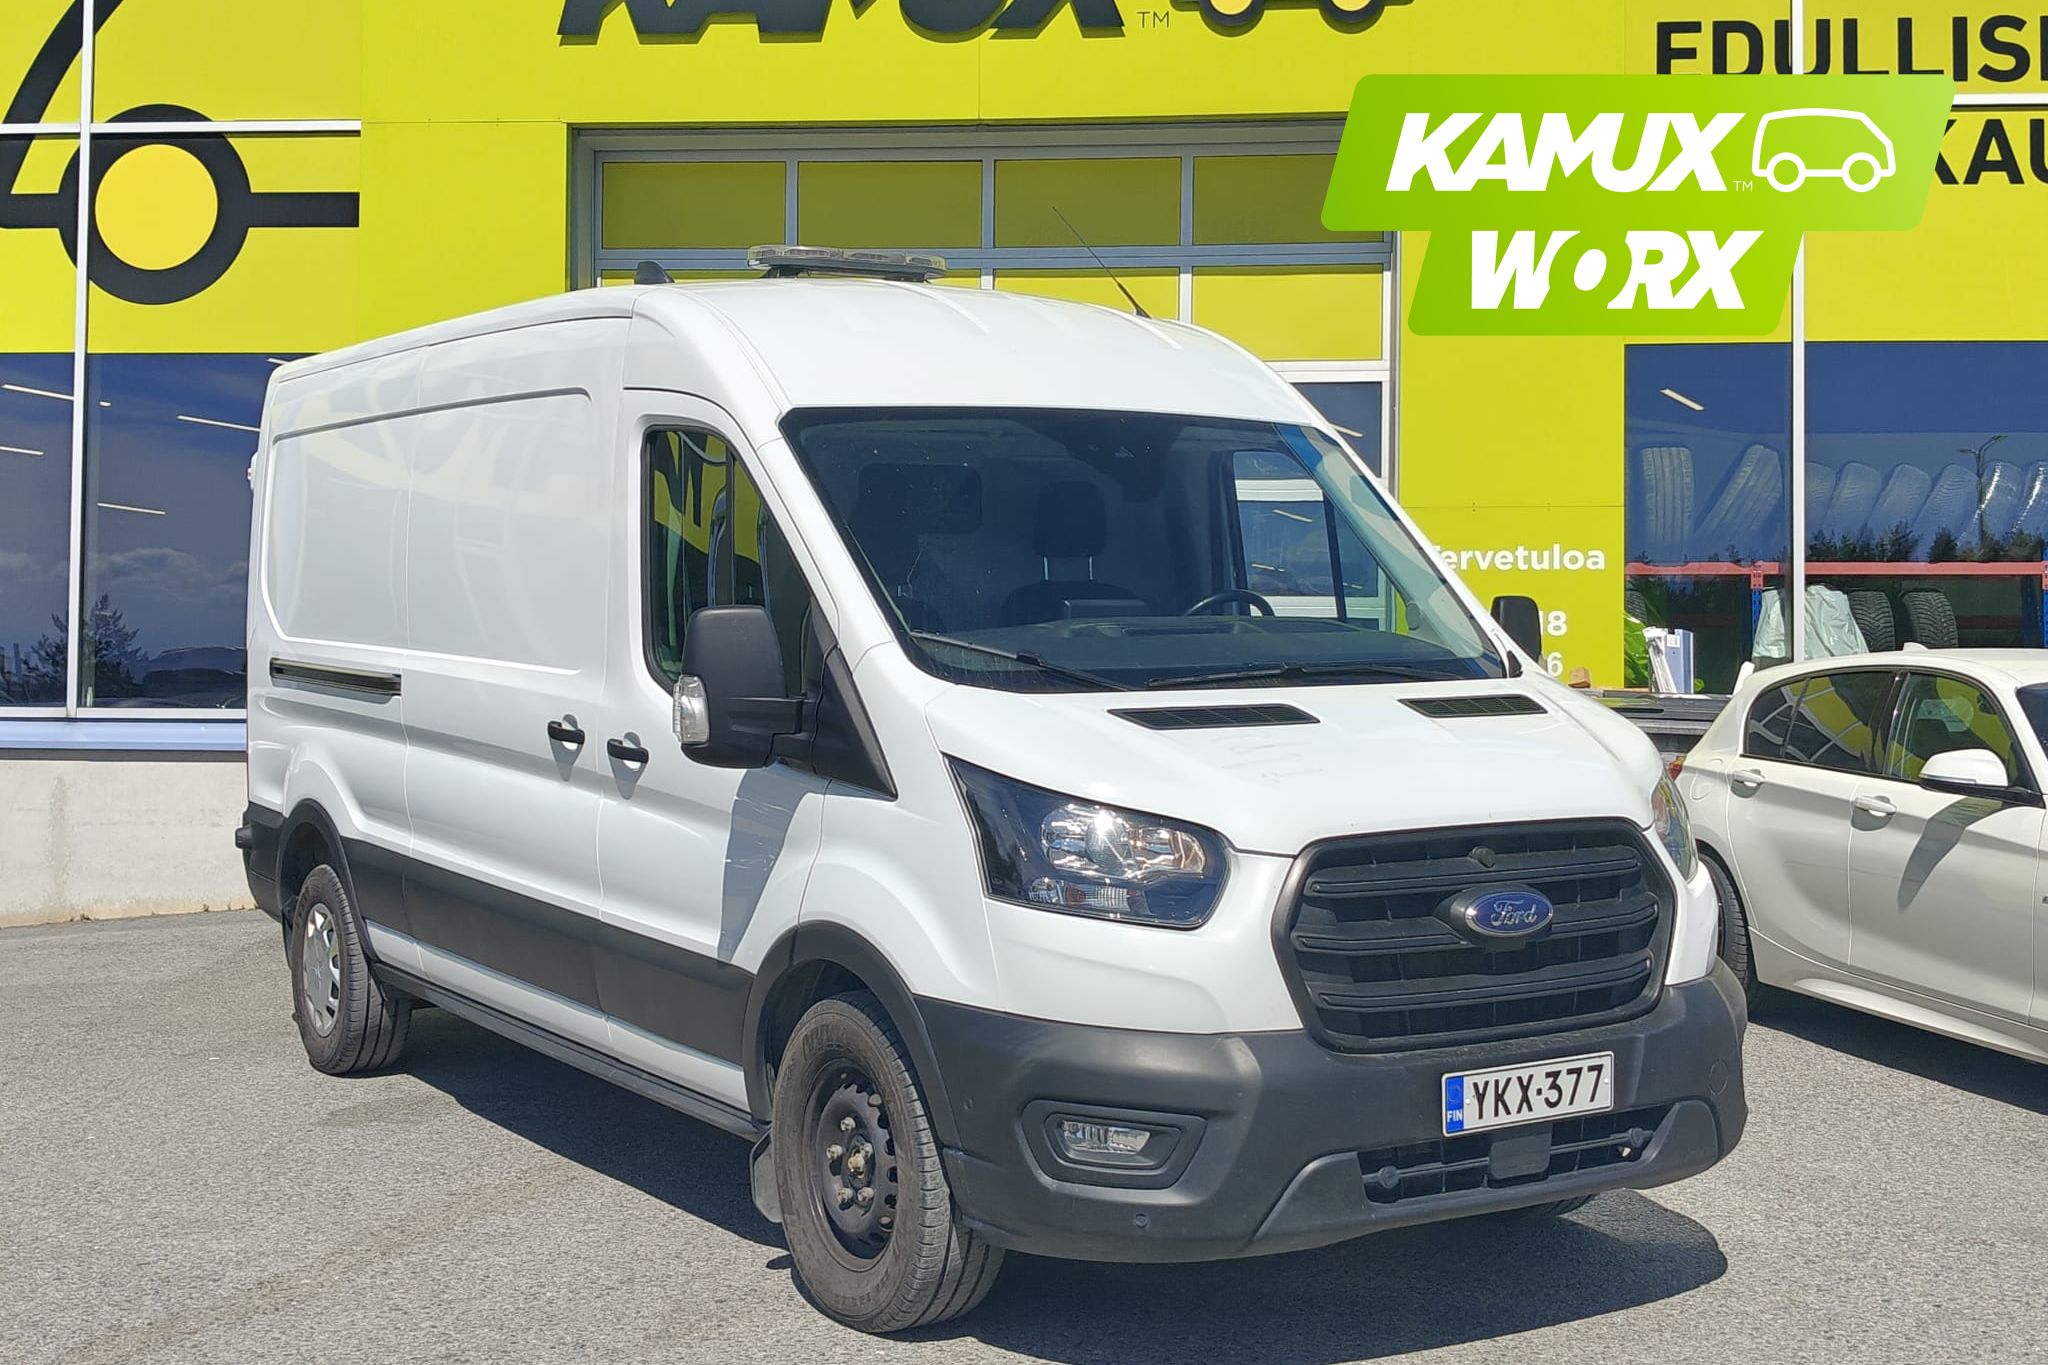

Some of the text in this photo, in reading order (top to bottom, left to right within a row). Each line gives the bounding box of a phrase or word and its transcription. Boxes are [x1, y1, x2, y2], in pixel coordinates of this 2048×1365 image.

[1656, 15, 2048, 82] EDULLIS
[1433, 543, 1606, 571] ervetuloa
[1491, 900, 1537, 927] Ford
[1472, 1064, 1604, 1120] YKX-377
[1447, 1109, 1463, 1123] FIN
